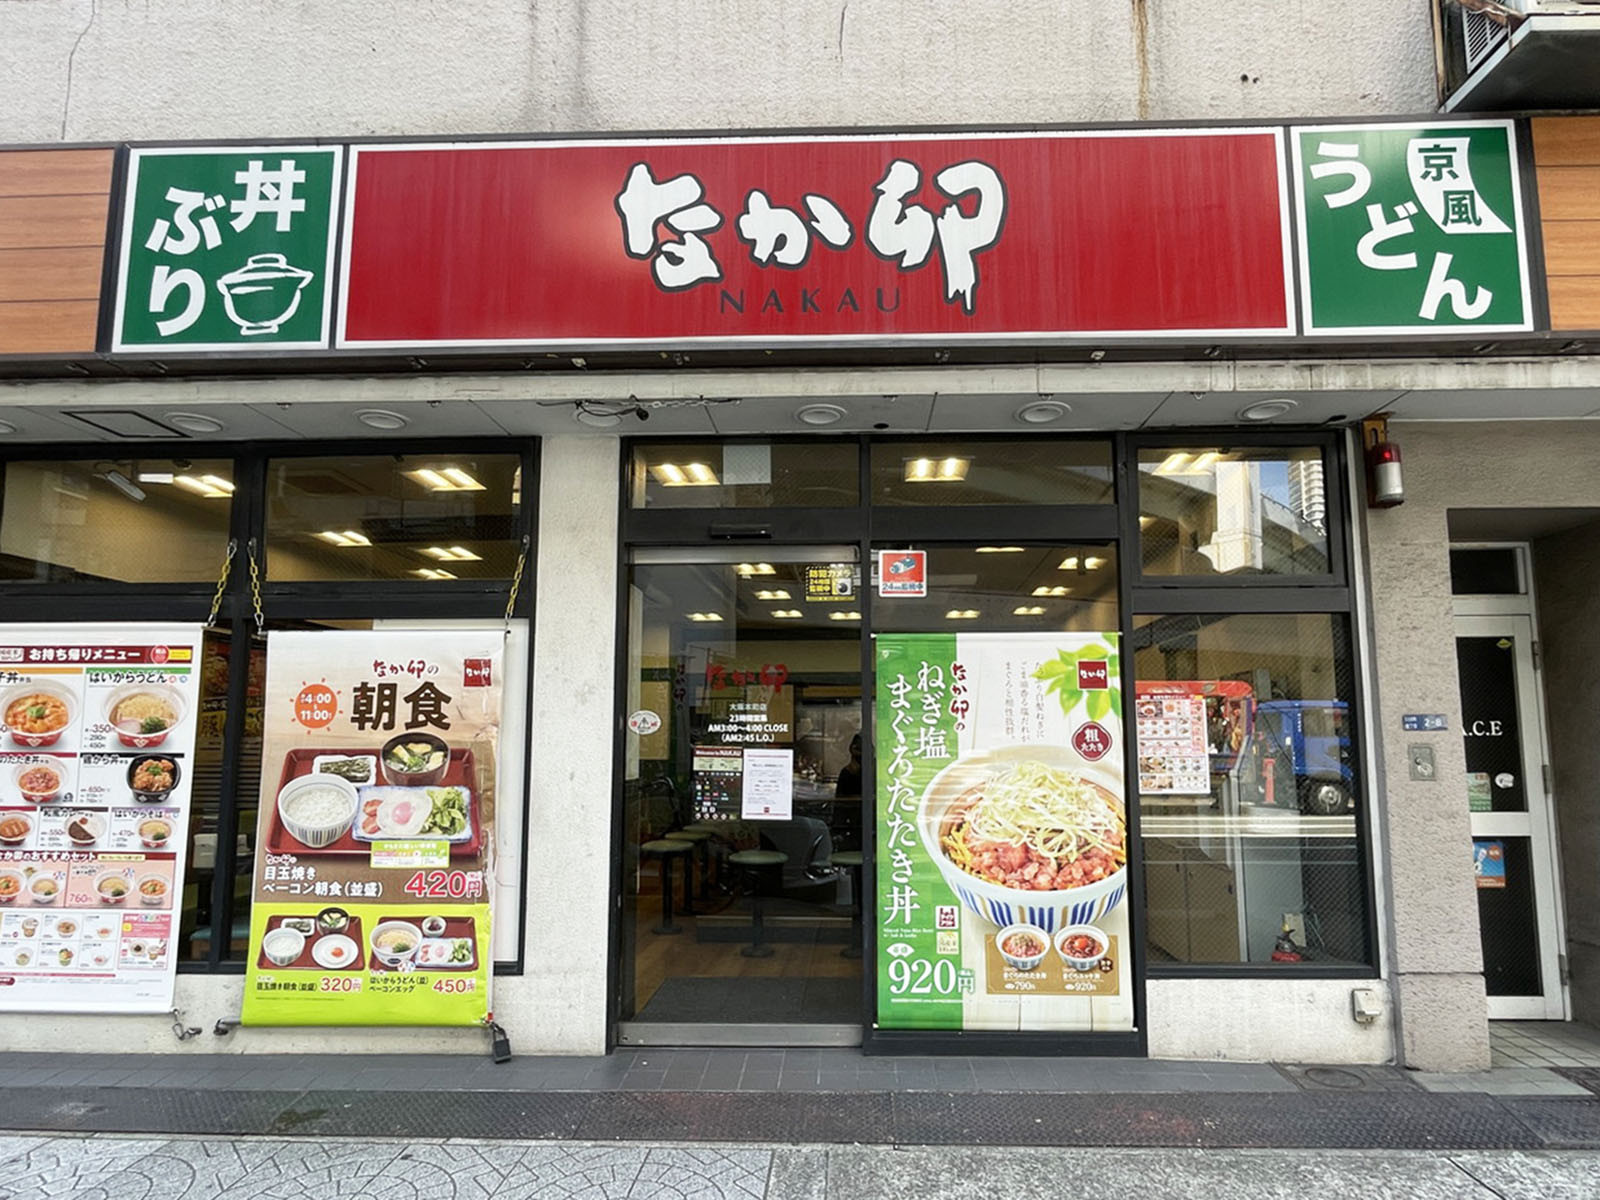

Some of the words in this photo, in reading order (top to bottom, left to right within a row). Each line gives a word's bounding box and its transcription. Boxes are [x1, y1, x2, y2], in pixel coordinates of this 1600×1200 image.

[1418, 144, 1482, 227] 京風
[614, 158, 1008, 316] なか卯
[1310, 141, 1493, 321] うどん
[720, 288, 902, 314] NAKAU
[29, 648, 141, 661] お持ち帰りメニュー
[373, 659, 440, 679] なか卯の
[89, 672, 168, 684] はいからうどん
[950, 662, 970, 731] なか卯の
[350, 681, 452, 730] 朝食
[914, 661, 951, 759] ねぎ塩
[763, 723, 789, 732] CLOSE
[1085, 728, 1100, 742] 粗
[884, 673, 920, 925] まぐろたたき丼
[264, 866, 317, 881] 目玉焼き
